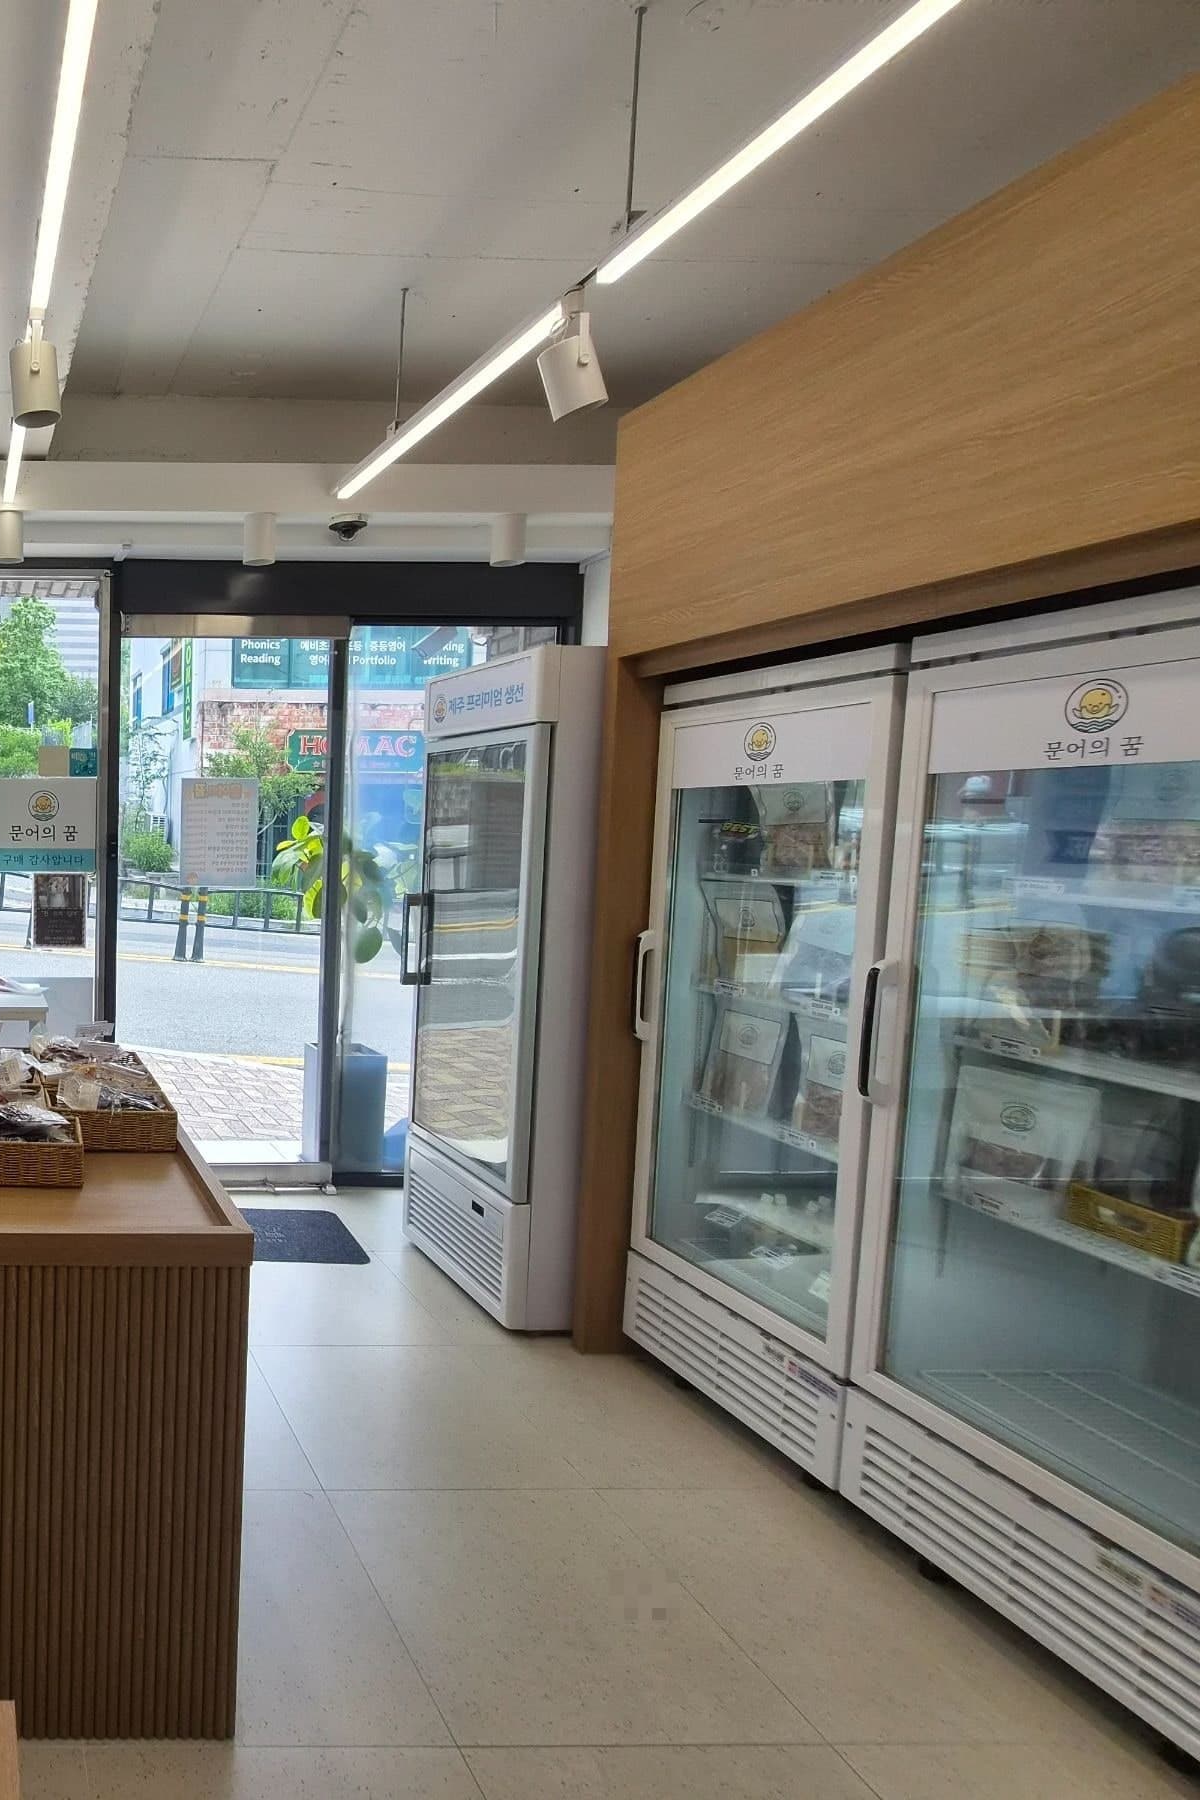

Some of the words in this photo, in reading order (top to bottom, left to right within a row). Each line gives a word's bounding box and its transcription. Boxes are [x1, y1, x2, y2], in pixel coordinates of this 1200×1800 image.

[240, 639, 281, 651] Phonics
[240, 653, 282, 667] Reading
[353, 654, 397, 667] Portfolio
[448, 695, 466, 716] 제주
[465, 687, 503, 711] 프리미엄
[504, 682, 525, 704] 생선
[1043, 737, 1109, 762] 문어의
[1119, 735, 1145, 757] 꿈
[733, 763, 768, 781] 문어의
[771, 763, 785, 780] 꿈
[8, 823, 57, 842] 문어의
[62, 824, 79, 843] 꿈
[722, 822, 758, 834] BEST
[2, 853, 25, 866] 구매
[28, 853, 86, 867] 감사합니다
